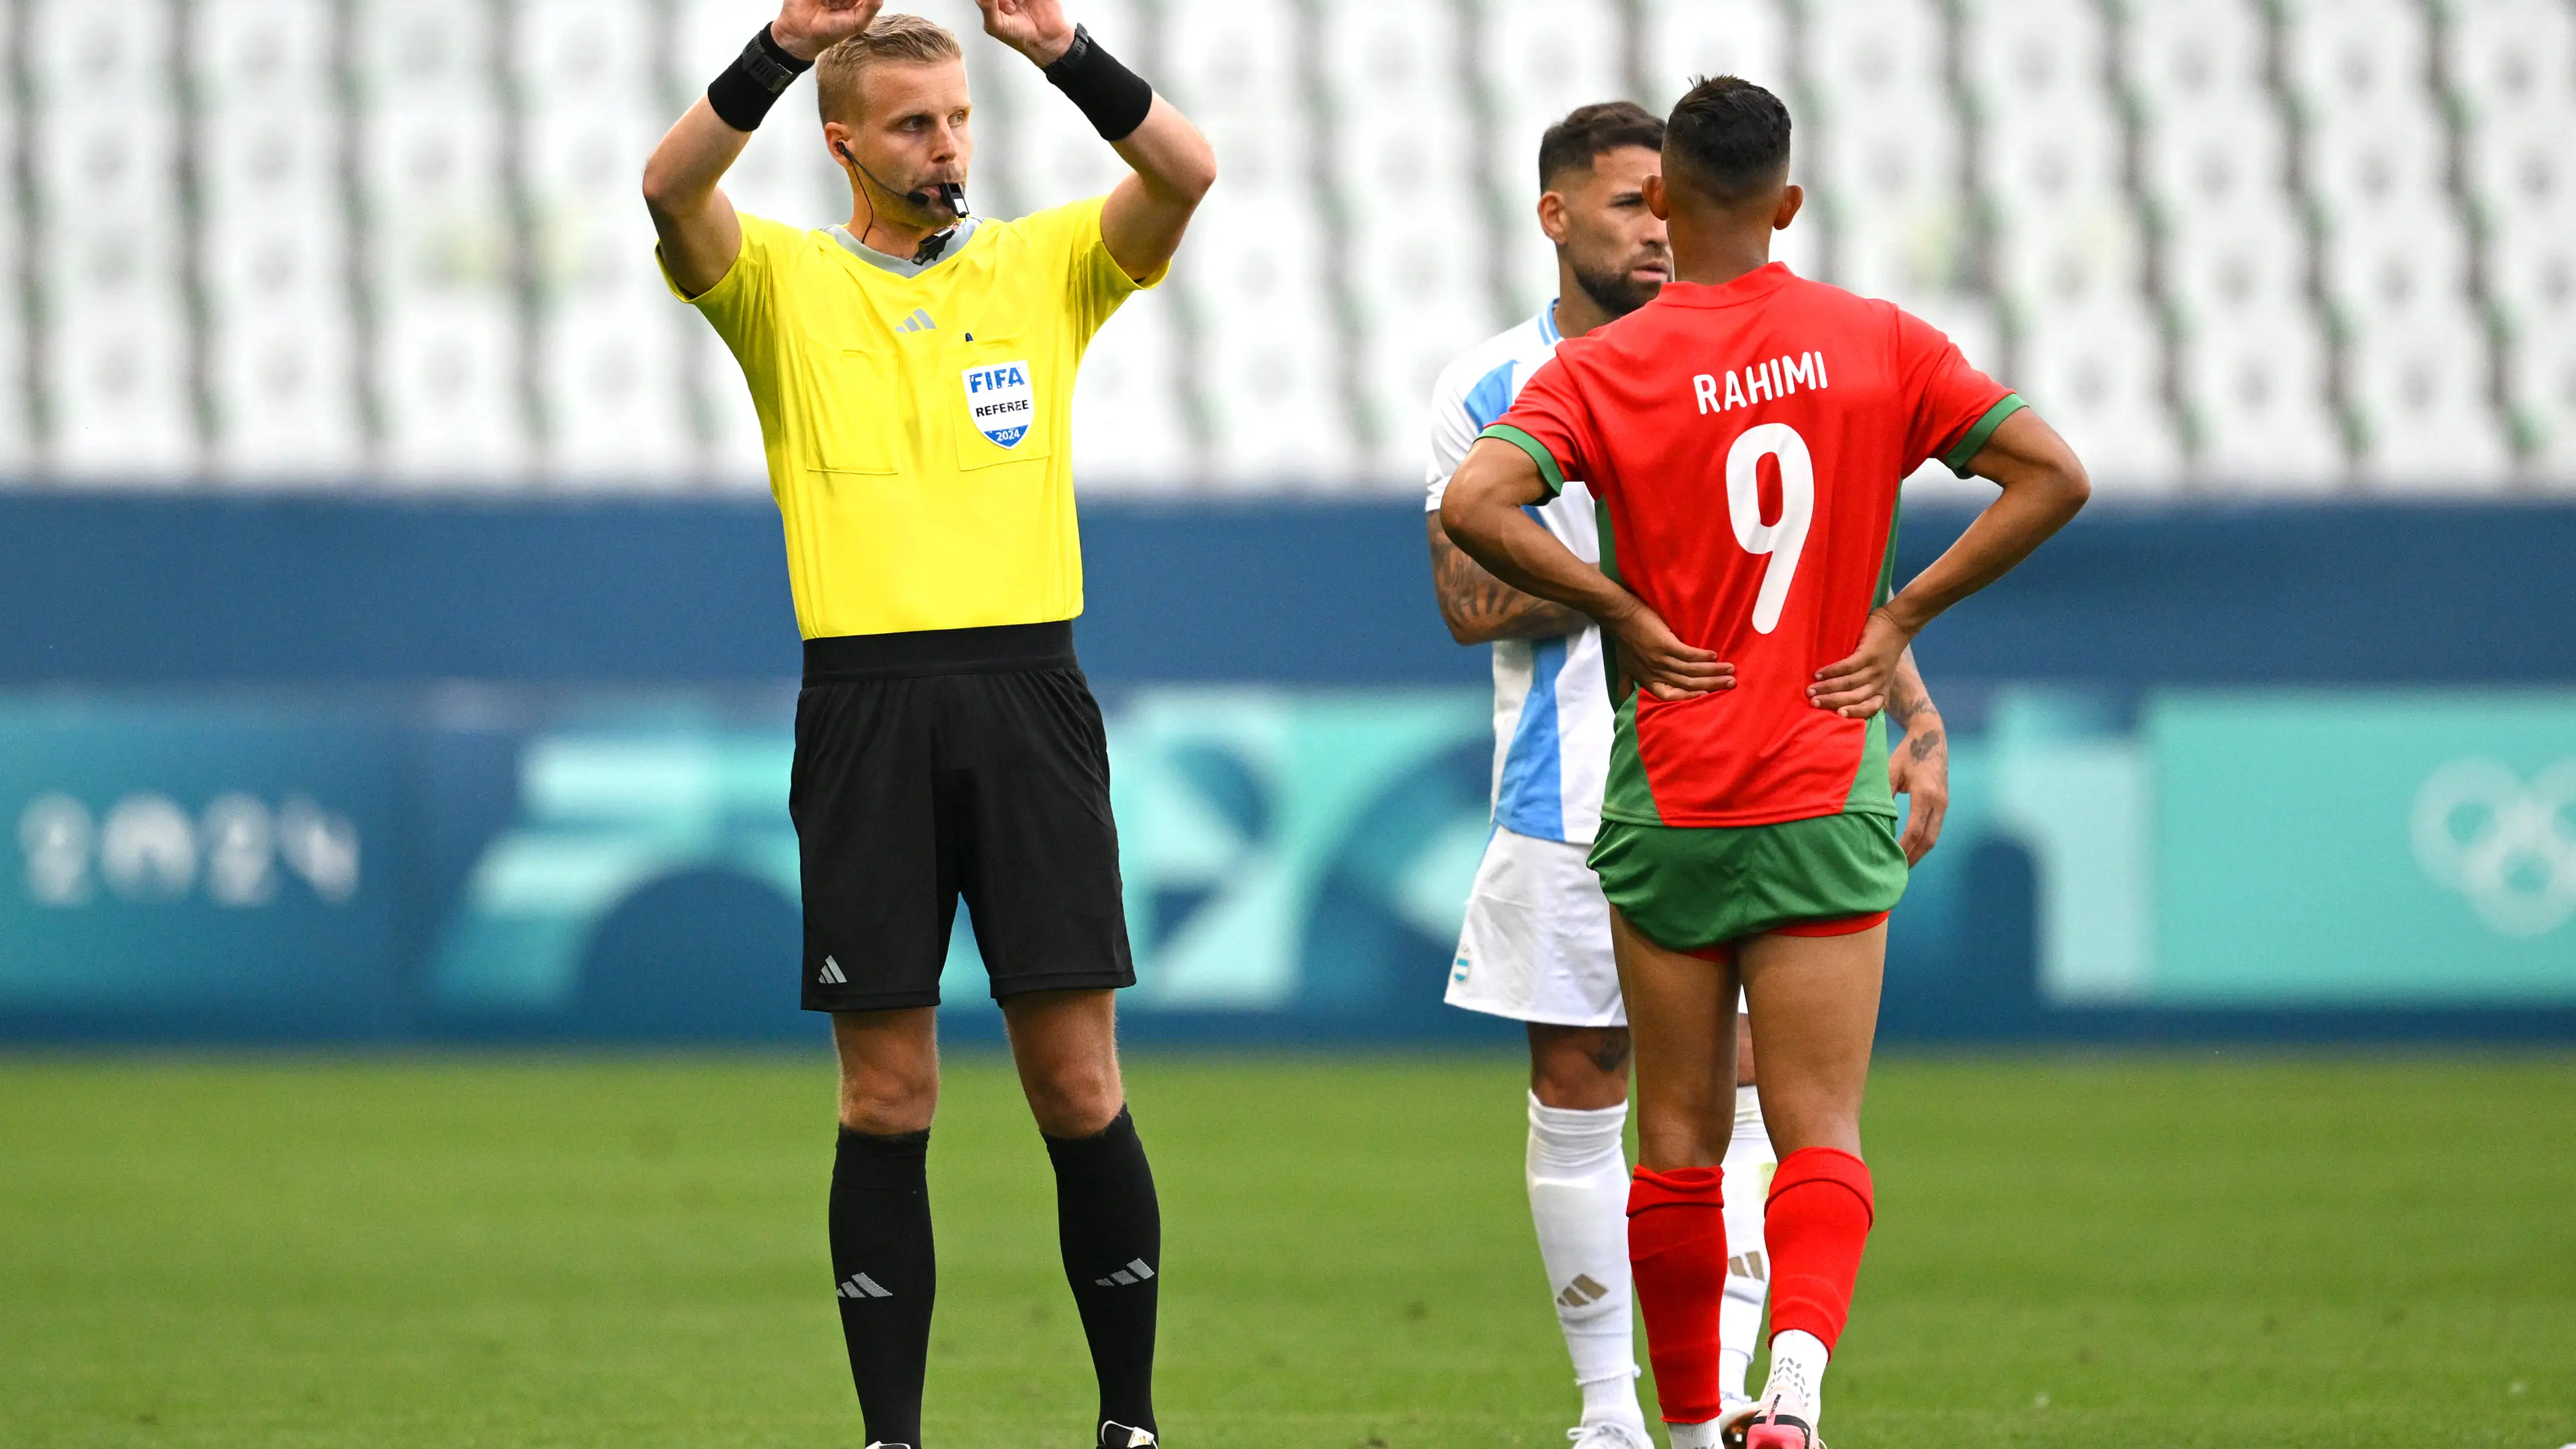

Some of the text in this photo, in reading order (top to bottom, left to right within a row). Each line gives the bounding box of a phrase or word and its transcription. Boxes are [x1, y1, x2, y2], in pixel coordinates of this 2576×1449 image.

[969, 367, 1025, 393] FIFA
[1693, 351, 1828, 414] RAHIMI
[975, 400, 1029, 417] REFEREE
[995, 430, 1020, 442] 2024
[1725, 422, 1814, 634] 9
[18, 794, 360, 904] 2024
